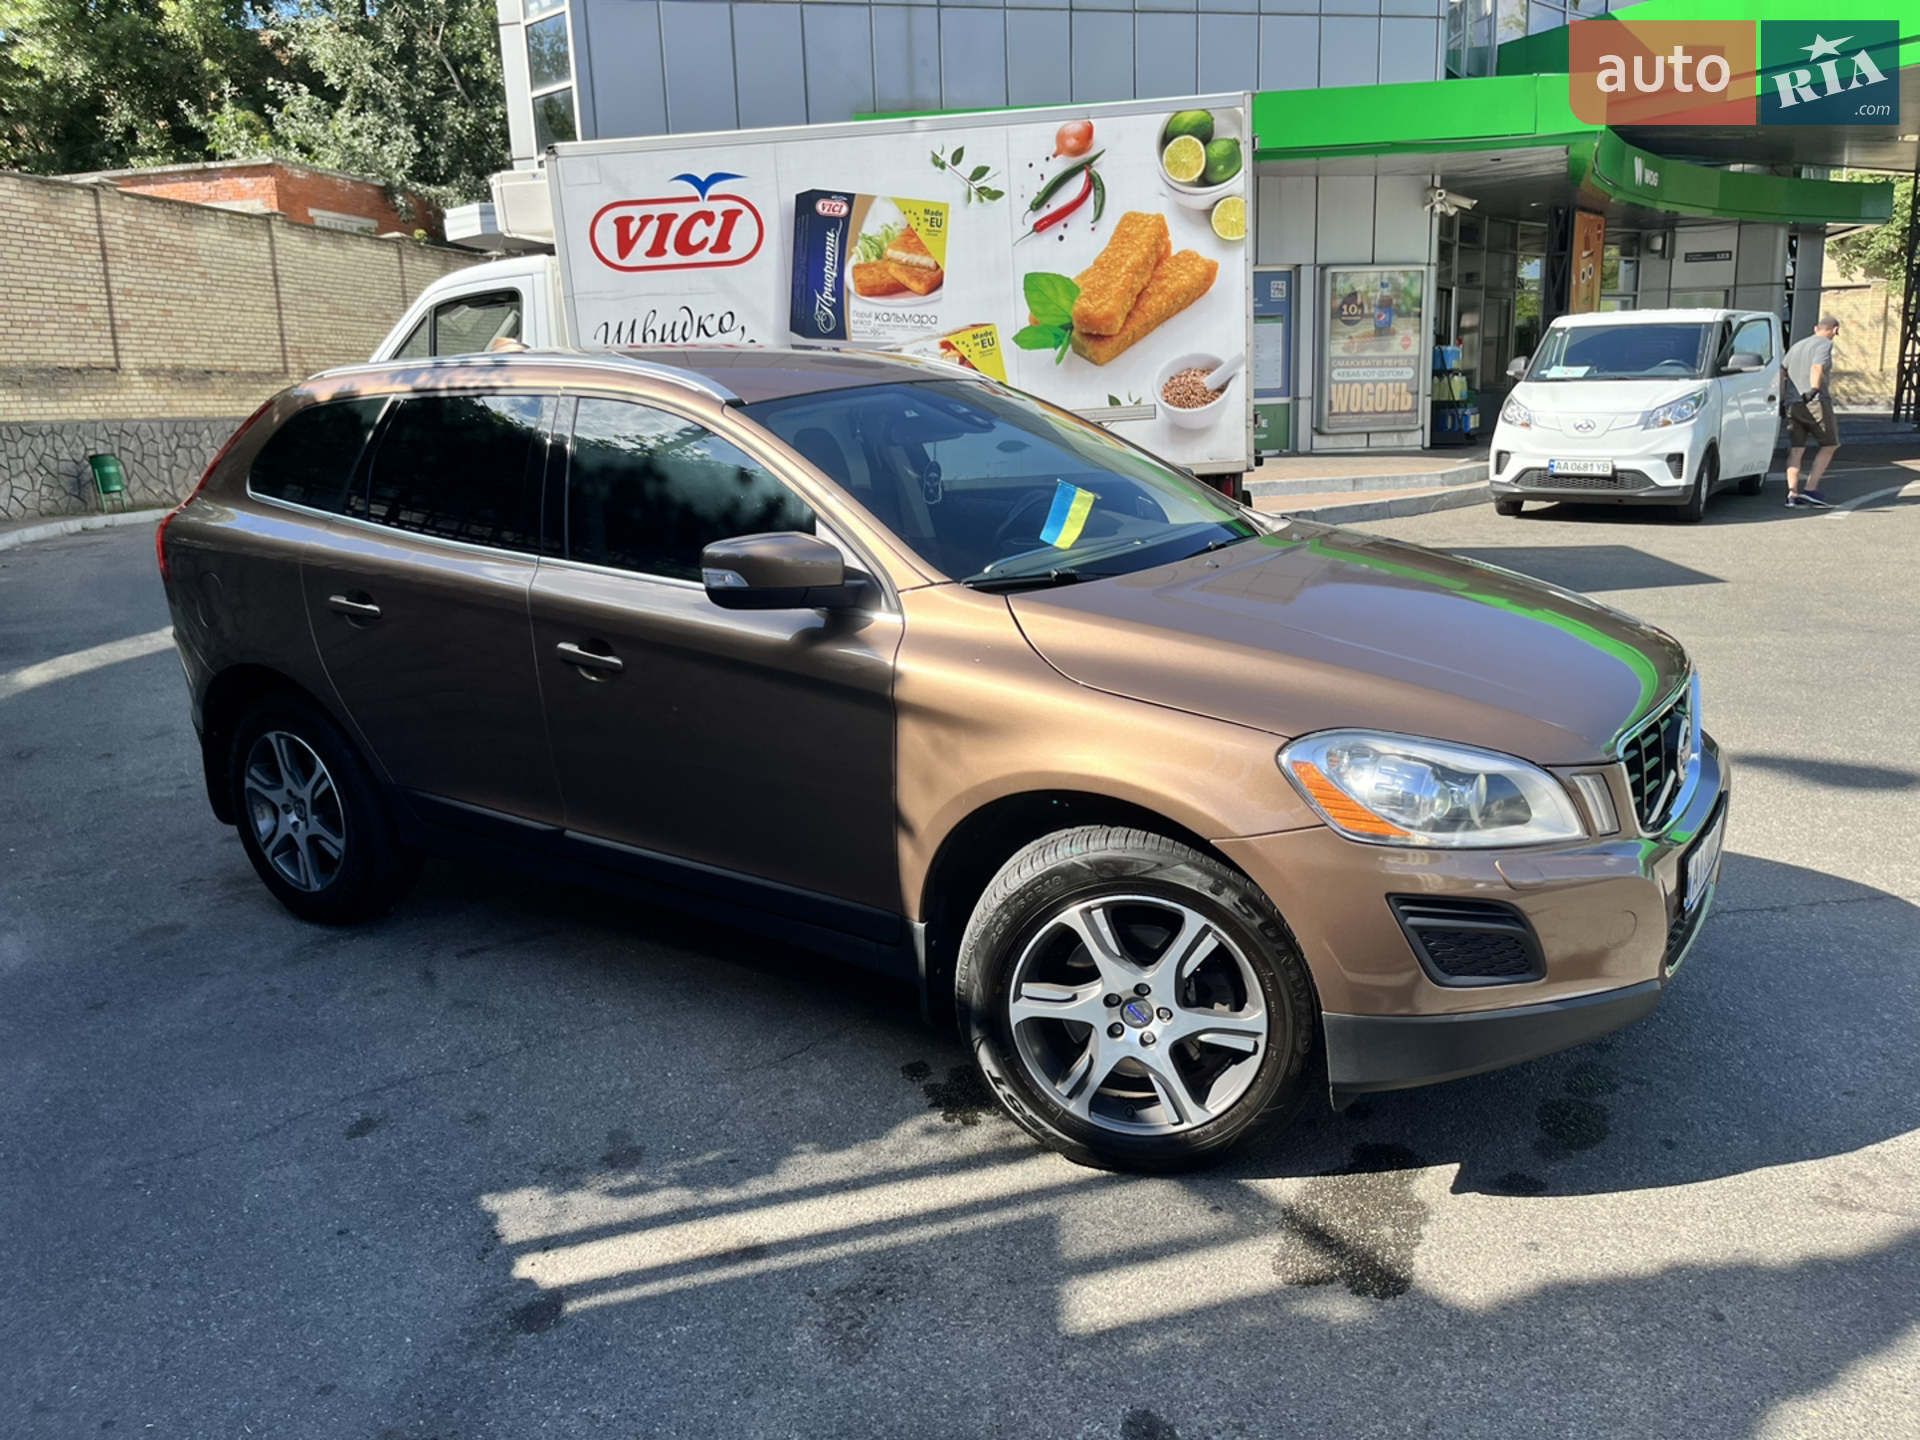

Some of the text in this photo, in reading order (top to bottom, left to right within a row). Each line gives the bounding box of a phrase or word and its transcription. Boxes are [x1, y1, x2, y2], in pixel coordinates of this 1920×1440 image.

[820, 201, 843, 214] VICI
[924, 208, 943, 217] Made
[930, 217, 943, 229] EU
[613, 208, 744, 261] VICI
[874, 311, 938, 329] кальмара
[981, 336, 995, 349] EU
[1555, 462, 1569, 471] AA
[1570, 462, 1594, 472] 0681
